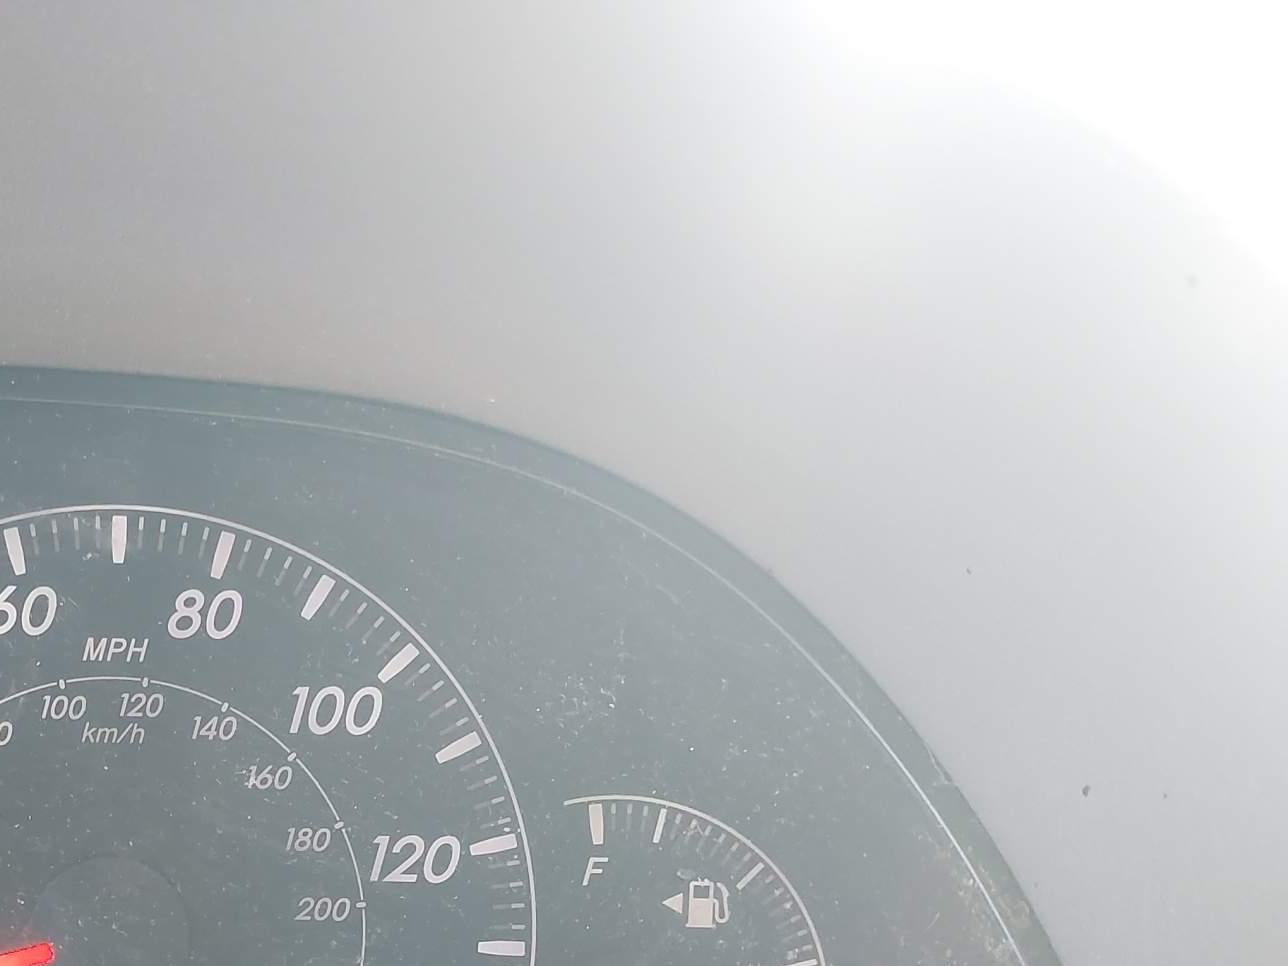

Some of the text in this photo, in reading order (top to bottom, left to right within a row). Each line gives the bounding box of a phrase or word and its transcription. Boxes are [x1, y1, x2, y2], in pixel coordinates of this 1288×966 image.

[167, 589, 244, 640] 80
[82, 637, 150, 664] MPH
[41, 695, 87, 721] 100
[119, 693, 165, 719] 120
[289, 685, 384, 737] 100
[80, 720, 146, 746] km/h
[191, 715, 238, 742] 140
[246, 764, 293, 791] 160
[285, 826, 331, 853] 180
[369, 834, 461, 884] 120
[582, 856, 609, 887] F
[294, 896, 351, 923] 200
